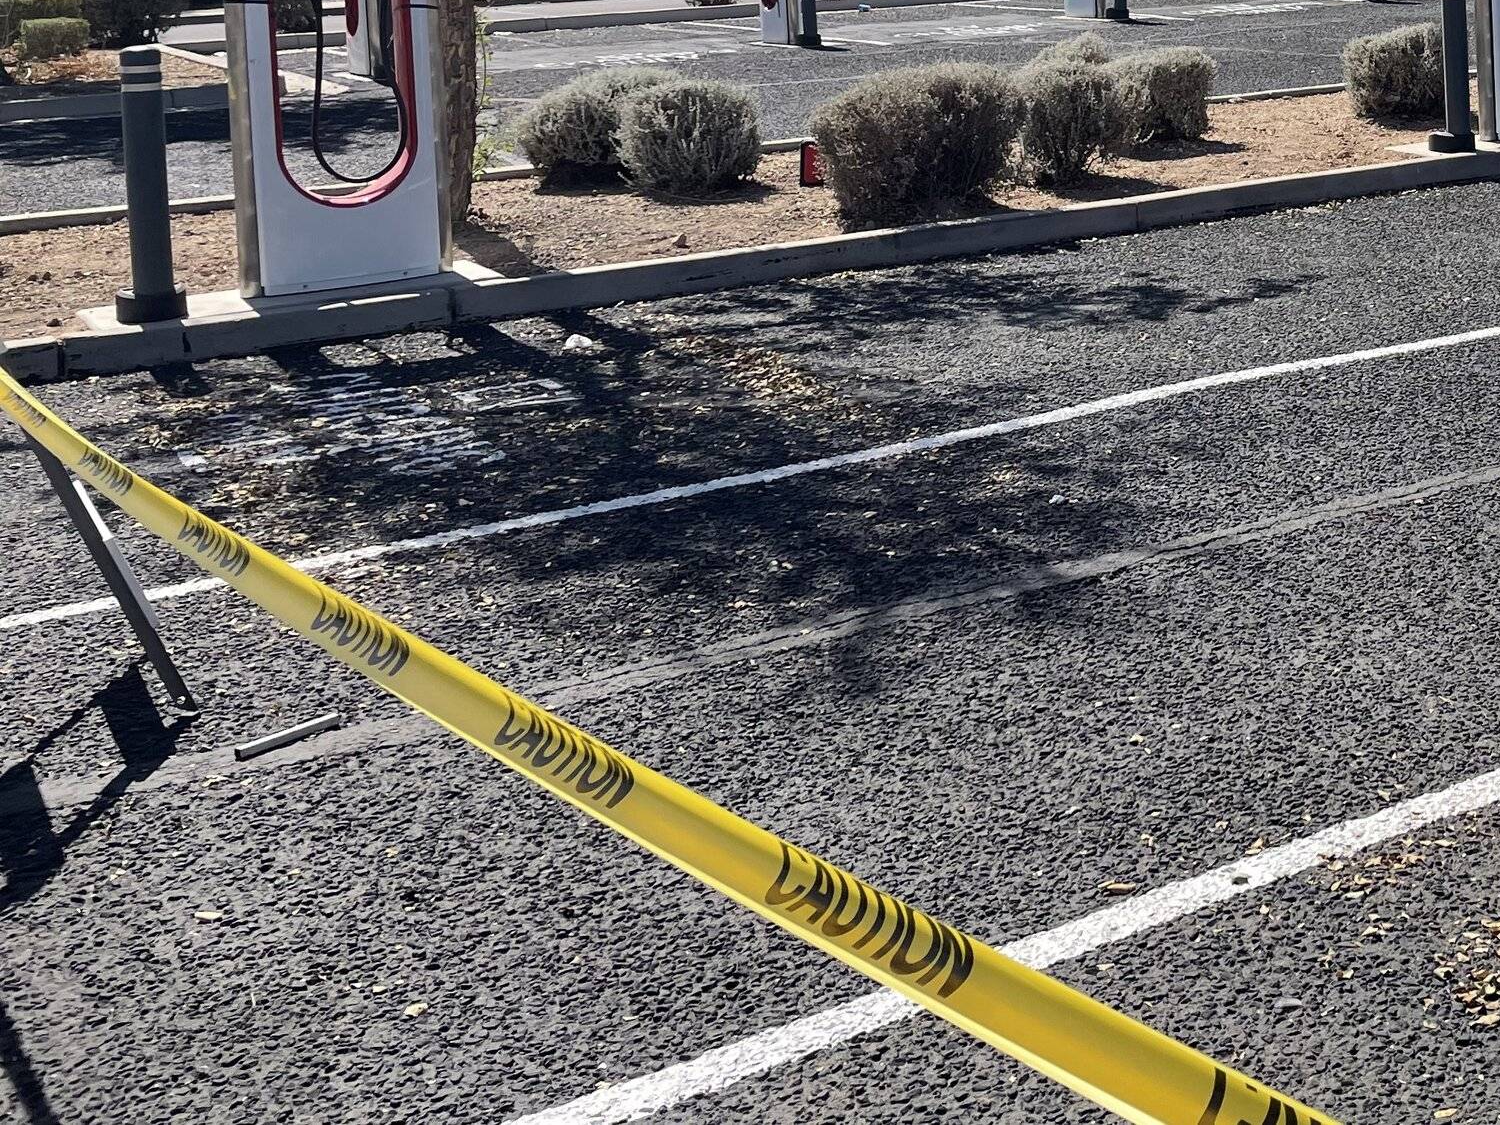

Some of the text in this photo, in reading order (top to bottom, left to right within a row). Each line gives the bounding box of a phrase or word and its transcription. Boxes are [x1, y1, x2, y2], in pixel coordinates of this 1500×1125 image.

[310, 583, 410, 676] CAUTION
[494, 692, 635, 809] CAUTION
[765, 841, 975, 999] CAUTION
